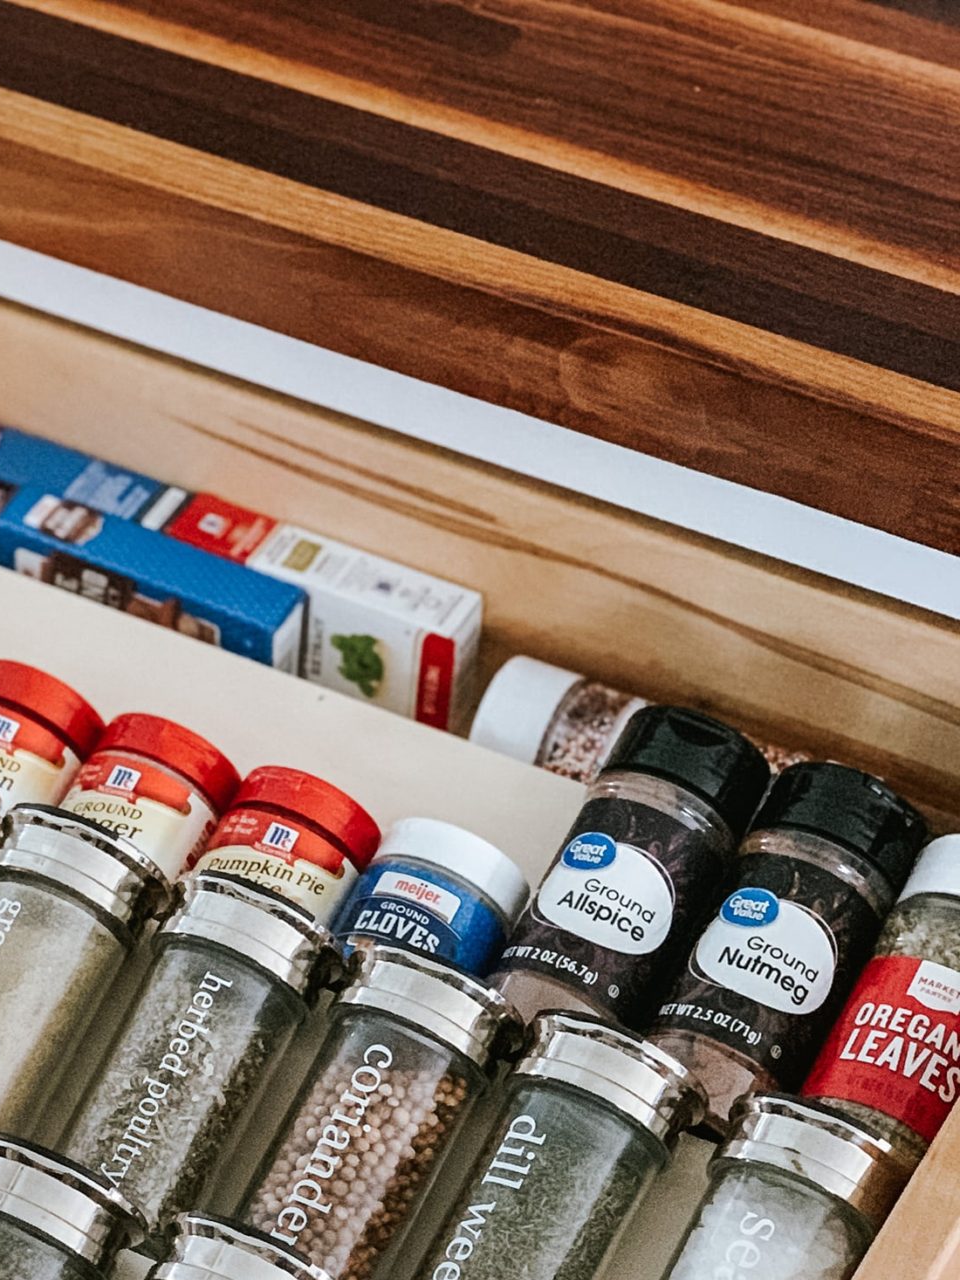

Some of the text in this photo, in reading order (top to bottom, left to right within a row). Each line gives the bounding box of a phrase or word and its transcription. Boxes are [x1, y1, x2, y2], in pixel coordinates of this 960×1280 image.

[72, 801, 143, 821] GROUND
[569, 840, 608, 857] Great
[208, 857, 326, 896] Pumpkin Pie
[394, 879, 442, 905] meijer
[379, 901, 430, 925] GROUND
[556, 890, 645, 941] Allspice
[584, 878, 656, 924] Ground
[728, 895, 771, 914] Great
[732, 908, 765, 921] Value
[354, 909, 441, 954] CLOVES
[516, 945, 533, 959] WT
[531, 948, 541, 960] 2
[541, 950, 557, 965] OZ
[555, 954, 599, 985] (56.7g)
[717, 946, 810, 1006] Nutmeg
[747, 936, 819, 984] Ground
[675, 1003, 694, 1017] WT
[691, 1006, 714, 1023] 2.5
[713, 1012, 733, 1028] OZ
[729, 1018, 763, 1045] (71g)
[854, 1002, 960, 1062] OREGAN
[100, 971, 234, 1188] herbed poultry
[839, 1028, 960, 1103] LEAVES
[481, 1114, 547, 1190] dill
